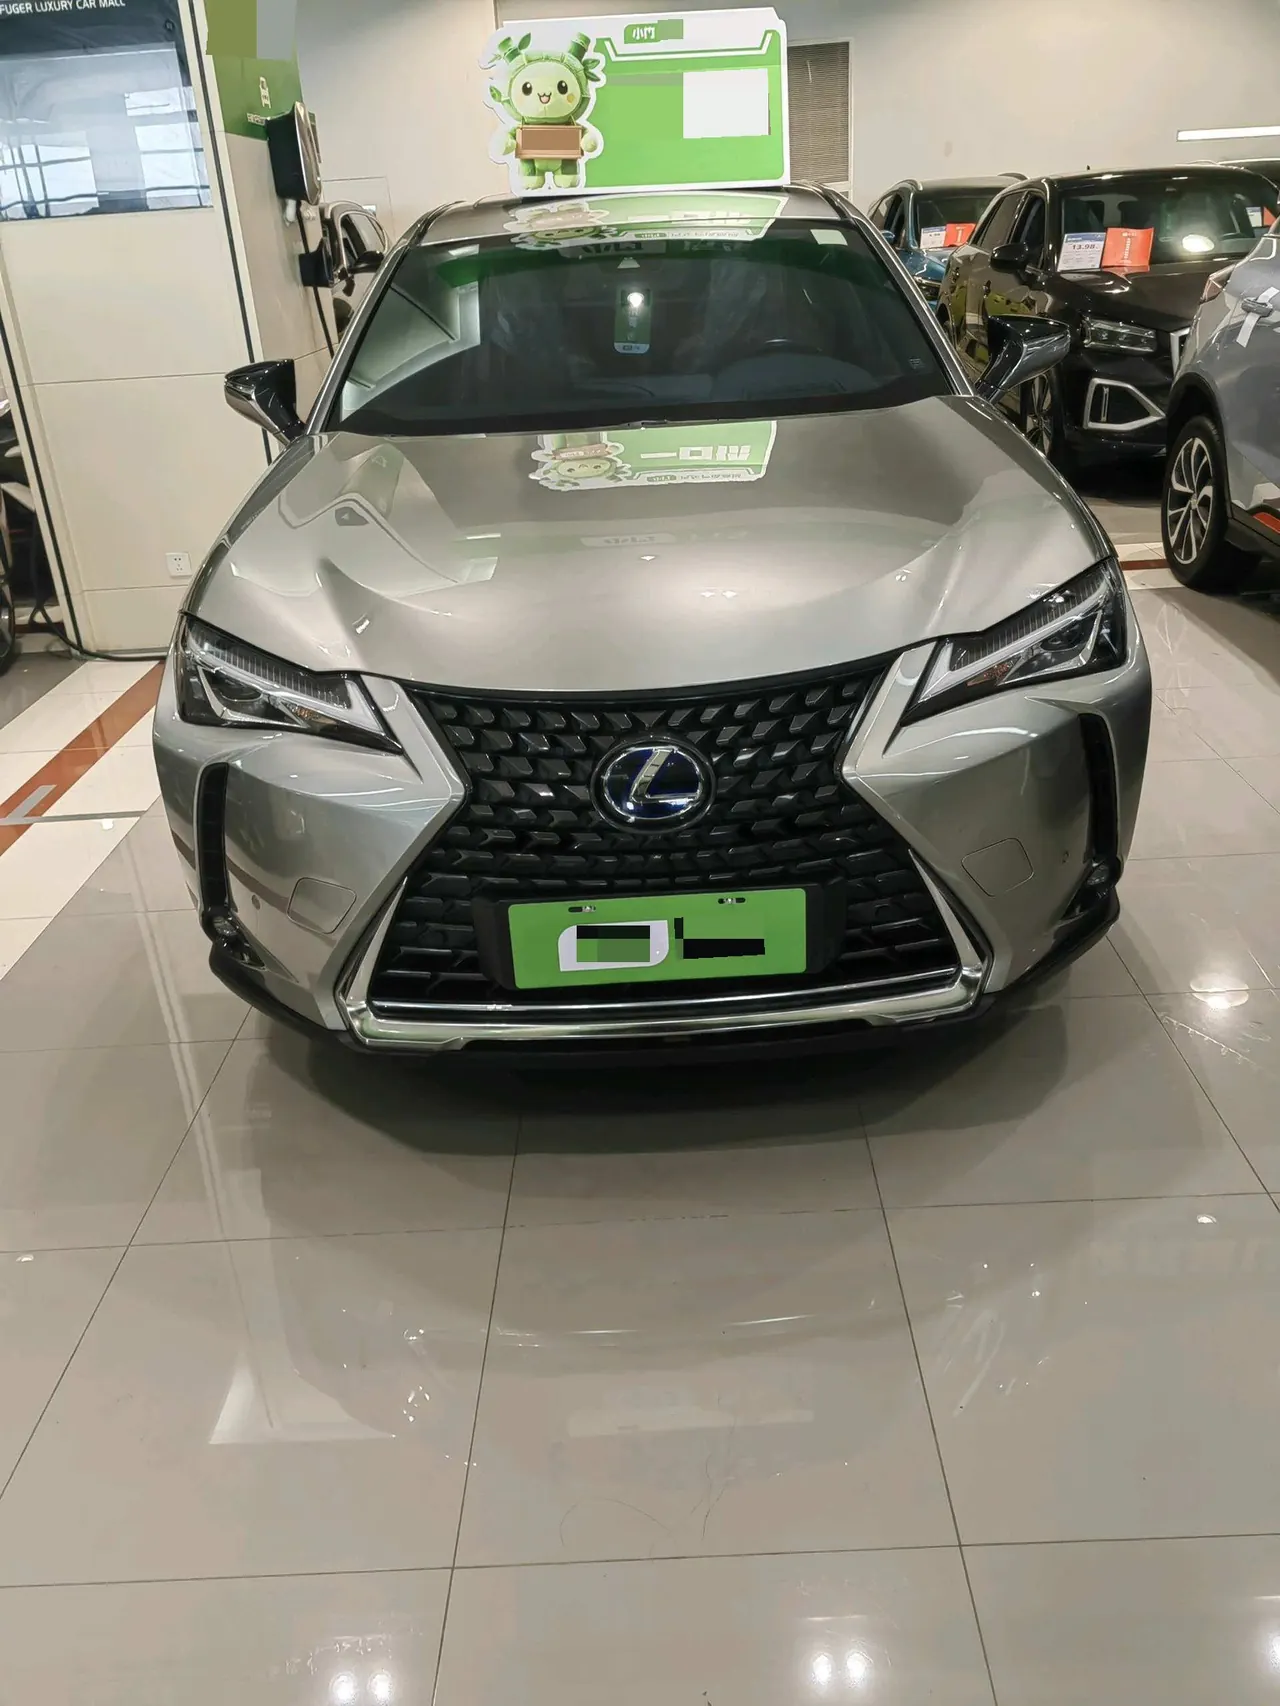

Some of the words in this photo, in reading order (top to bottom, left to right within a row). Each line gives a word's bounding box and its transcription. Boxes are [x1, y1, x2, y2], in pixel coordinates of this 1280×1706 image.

[0, 3, 33, 15] FUGER
[35, 0, 73, 12] LUXURY
[76, 0, 97, 10] CAR
